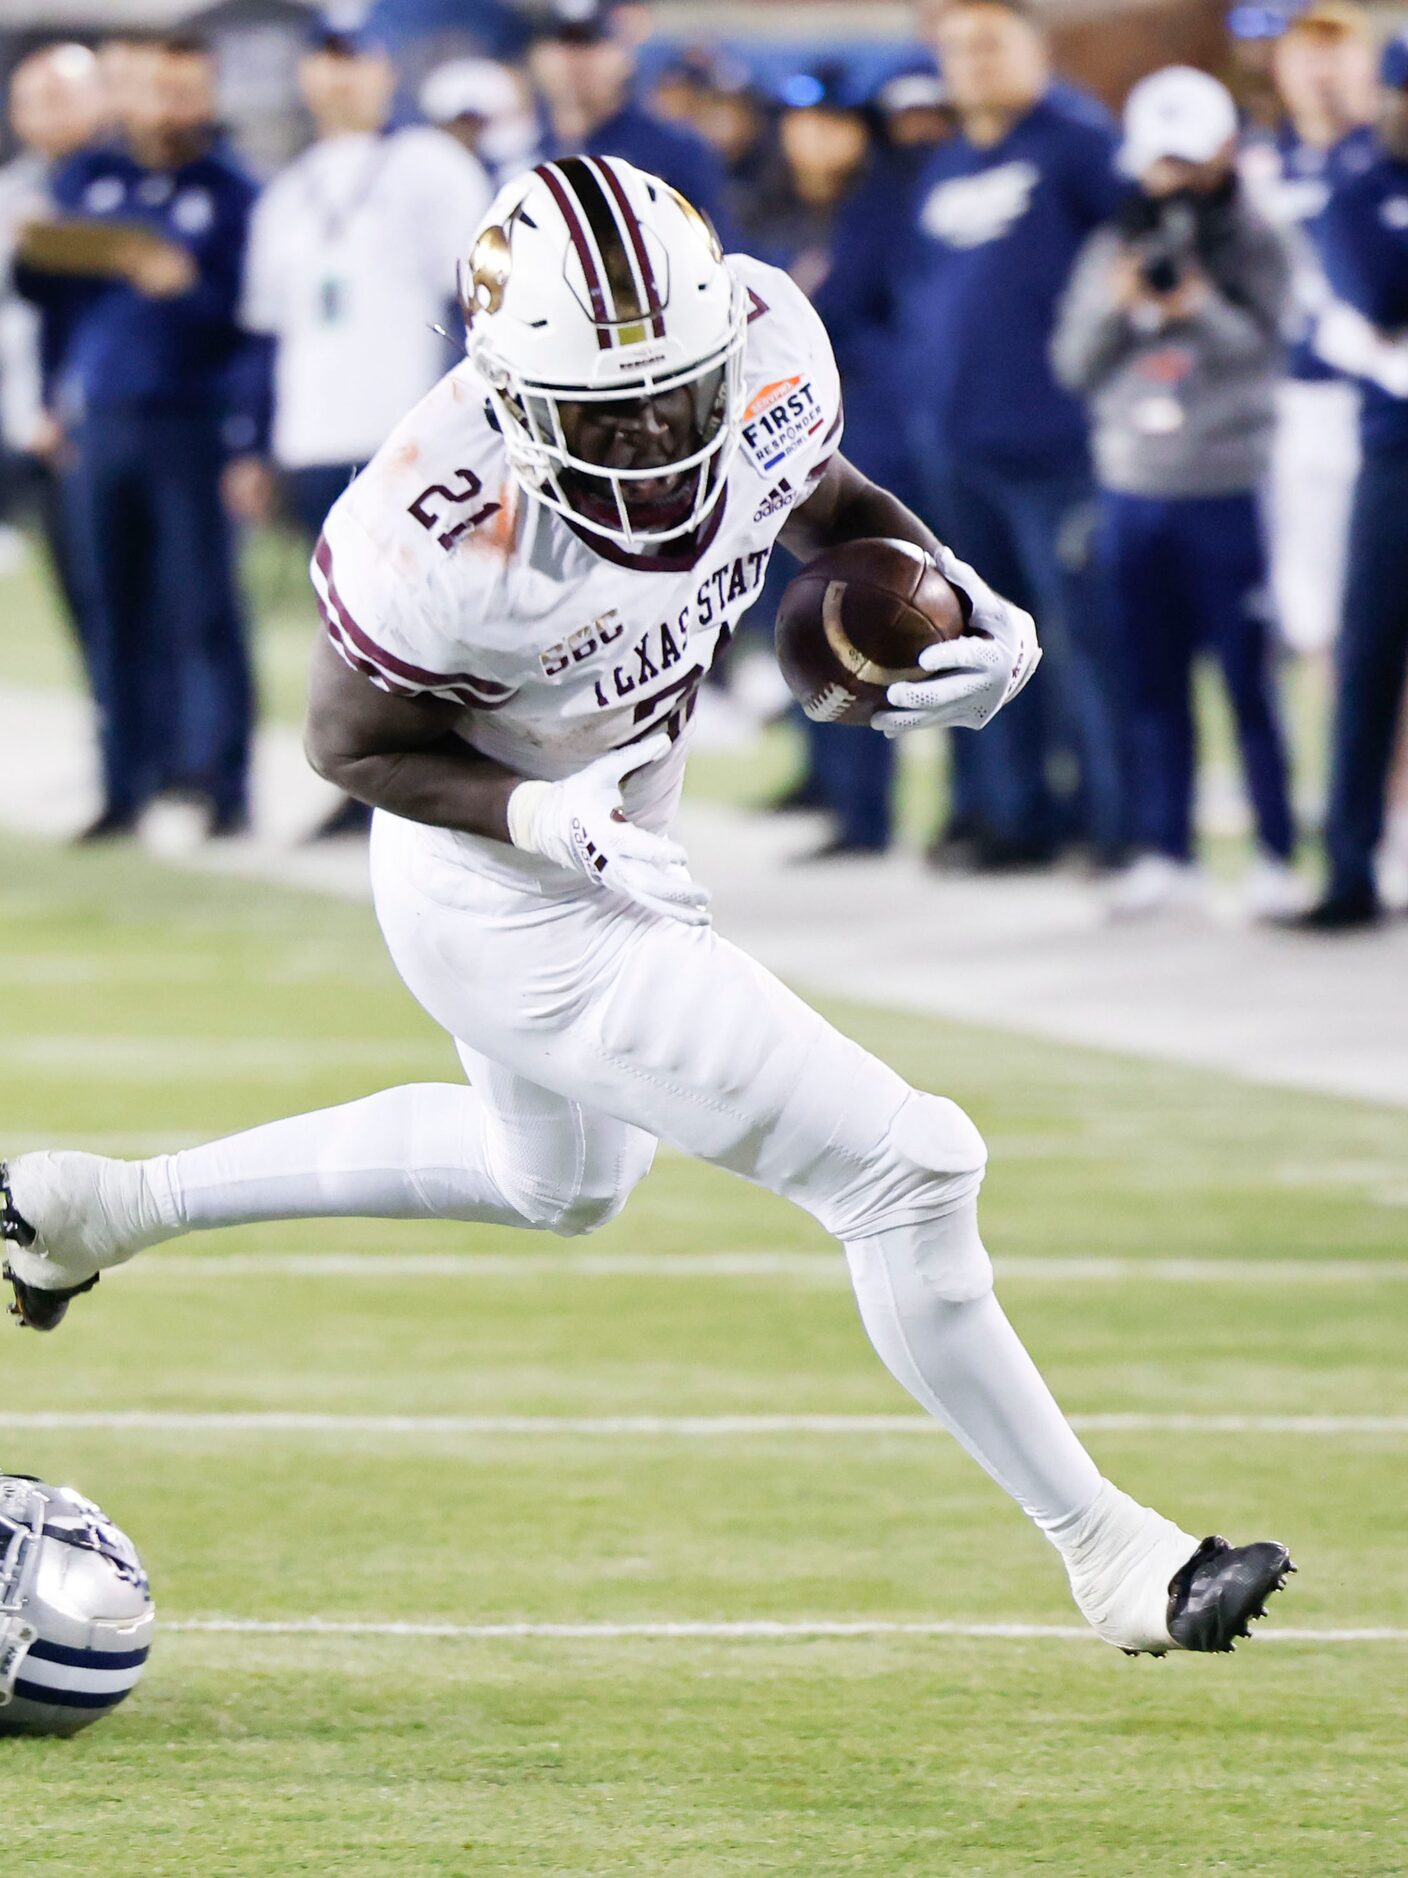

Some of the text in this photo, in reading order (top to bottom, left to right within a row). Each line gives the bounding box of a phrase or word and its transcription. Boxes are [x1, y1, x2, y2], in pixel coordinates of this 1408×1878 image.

[742, 383, 814, 449] F1RST
[755, 405, 822, 461] RESPONDER
[407, 468, 503, 552] 21
